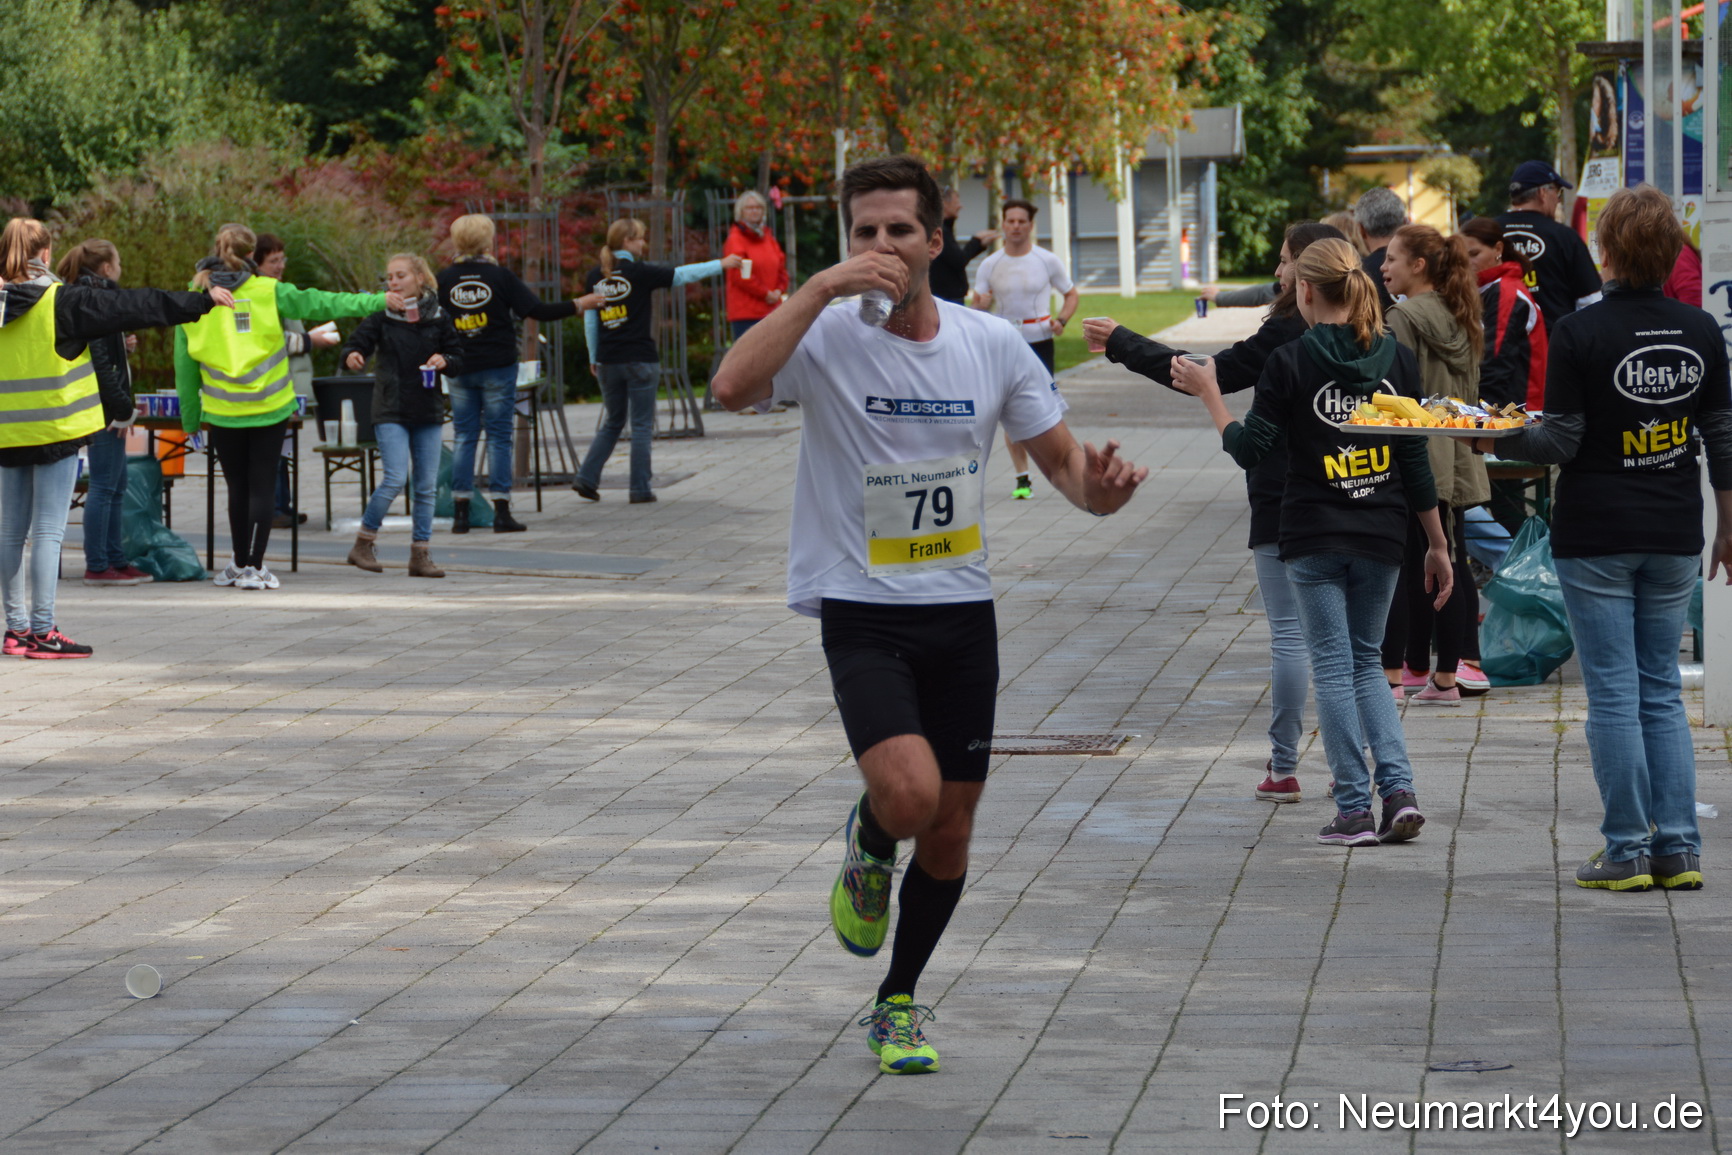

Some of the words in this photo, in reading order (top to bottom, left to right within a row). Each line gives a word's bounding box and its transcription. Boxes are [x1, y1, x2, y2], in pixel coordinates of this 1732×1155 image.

[454, 312, 488, 331] NEU
[1635, 329, 1683, 337] www.hervis.com
[1626, 360, 1699, 390] Hervis
[1632, 386, 1668, 394] SPORTS
[900, 402, 972, 414] BÜSCHEL
[1623, 416, 1688, 456] NEU
[1323, 445, 1391, 480] NEU
[1623, 458, 1635, 467] IN
[1637, 444, 1689, 467] NEUMARKT
[866, 475, 909, 487] PARTL
[911, 466, 966, 484] Neumarkt
[1340, 472, 1391, 489] NEUMARKT
[904, 485, 954, 531] 79
[909, 538, 952, 559] Frank
